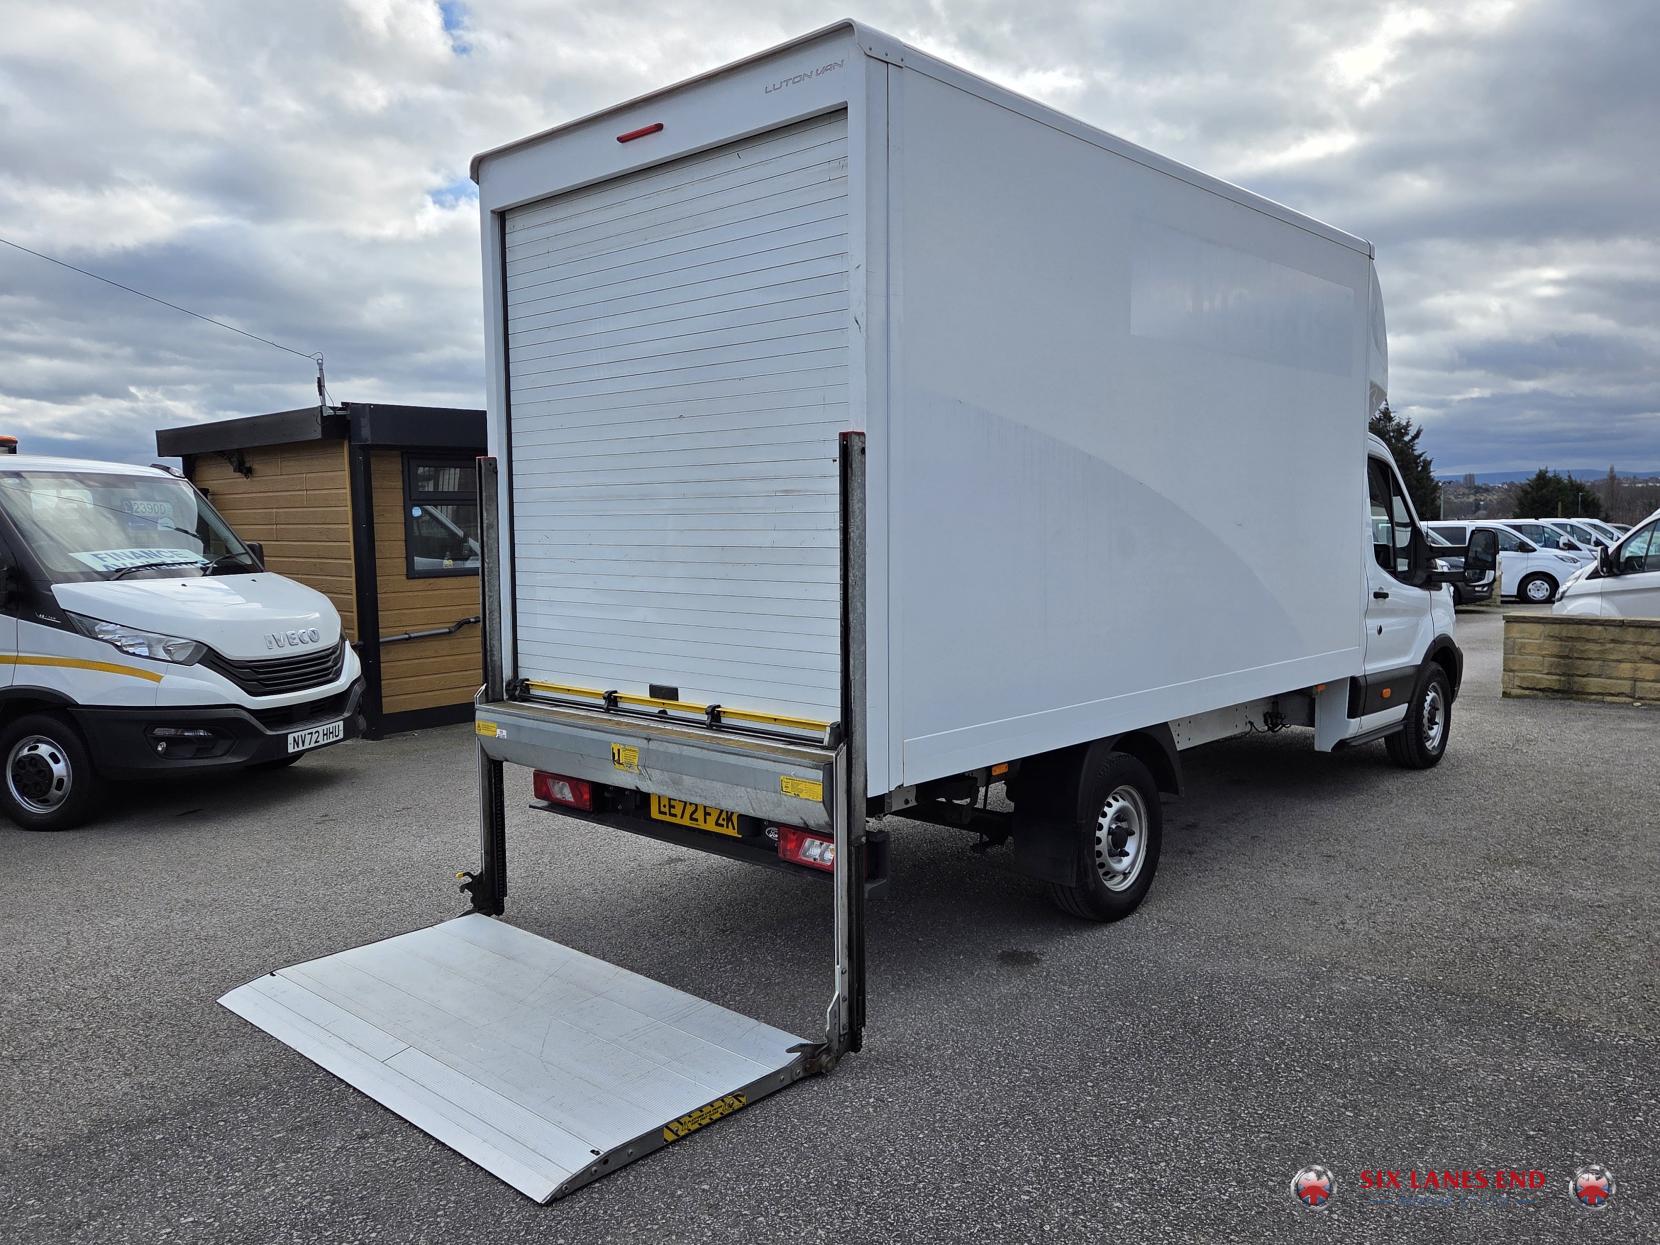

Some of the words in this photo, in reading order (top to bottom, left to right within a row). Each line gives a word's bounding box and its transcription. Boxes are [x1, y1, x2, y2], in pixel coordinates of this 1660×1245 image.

[765, 70, 814, 94] LUTON
[815, 59, 845, 76] VAN
[90, 549, 190, 563] FINANCE
[264, 627, 321, 650] IVECO
[292, 730, 321, 750] NV72
[322, 724, 341, 743] HHU
[658, 795, 699, 823] LE72
[703, 805, 737, 831] FZK
